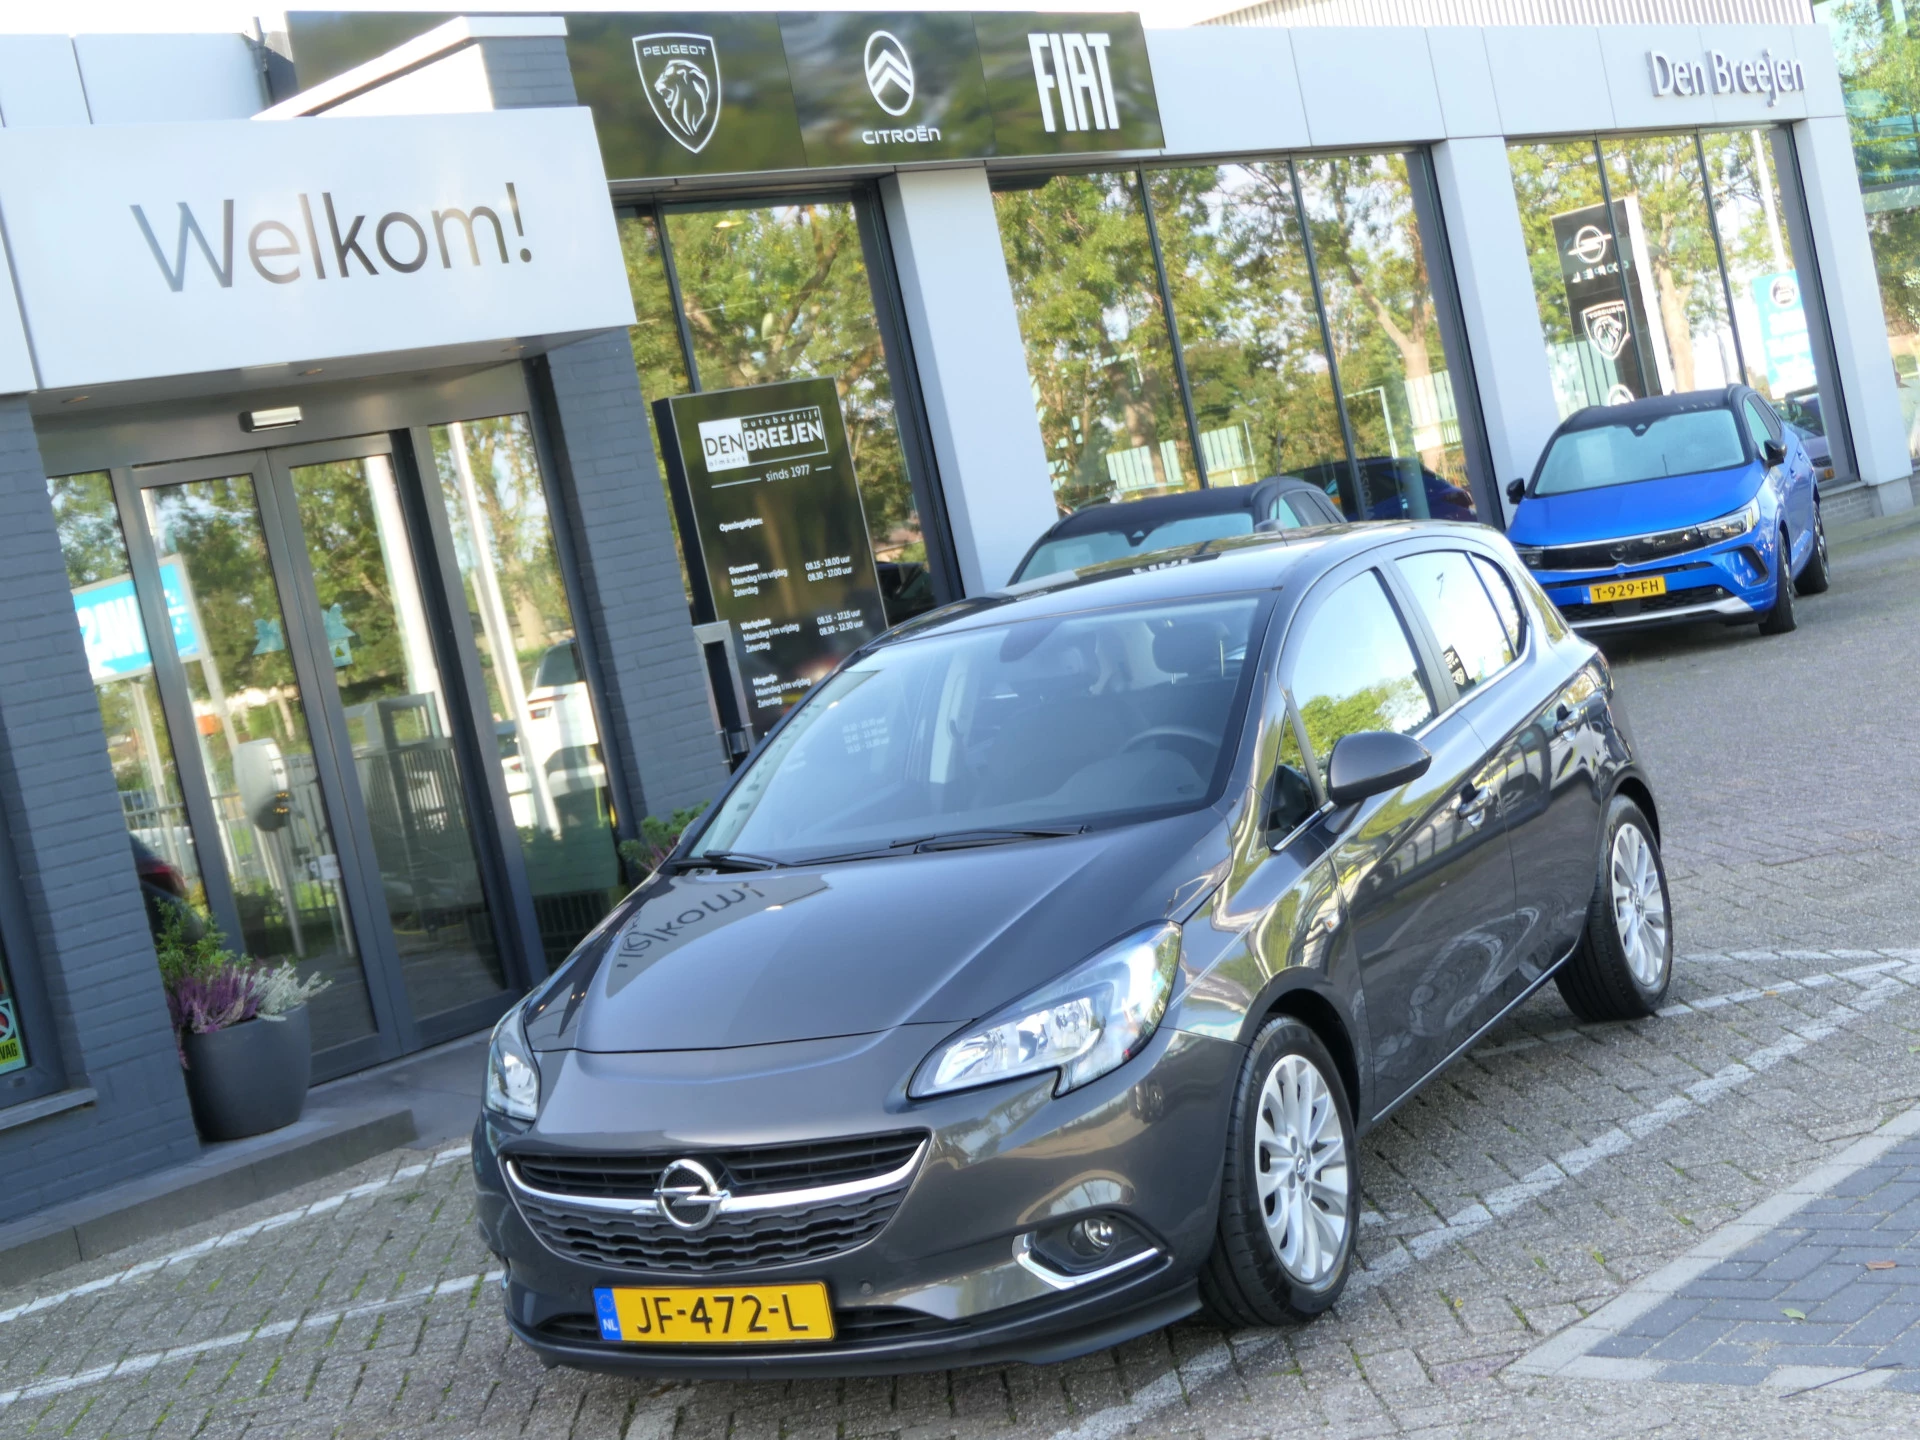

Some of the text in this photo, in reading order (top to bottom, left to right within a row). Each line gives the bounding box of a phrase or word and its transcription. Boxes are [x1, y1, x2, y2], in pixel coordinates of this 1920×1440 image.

[642, 44, 707, 56] PEUGEOT
[1027, 32, 1120, 132] FIAT
[1645, 48, 1807, 107] Den Breejen
[862, 125, 941, 145] CITROËN
[129, 181, 533, 293] Welkom!
[742, 409, 819, 429] autobedrijf
[704, 420, 824, 457] DEN BREEJEN
[766, 464, 811, 482] sinds 1977
[840, 555, 851, 564] uur
[730, 574, 759, 586] Maandag
[768, 568, 789, 580] vrijdag
[842, 566, 853, 575] uur
[733, 585, 759, 598] Zaterdag
[1593, 580, 1660, 600] T-929-FH
[850, 609, 861, 618] uur
[742, 629, 770, 641] Maandag
[779, 623, 800, 634] vrijdag
[853, 619, 864, 628] uur
[745, 641, 771, 653] Zaterdag
[754, 684, 781, 697] Maandag
[791, 677, 812, 689] vrijdag
[757, 696, 783, 708] Zaterdag
[602, 1292, 809, 1334] NL JF-472-L
